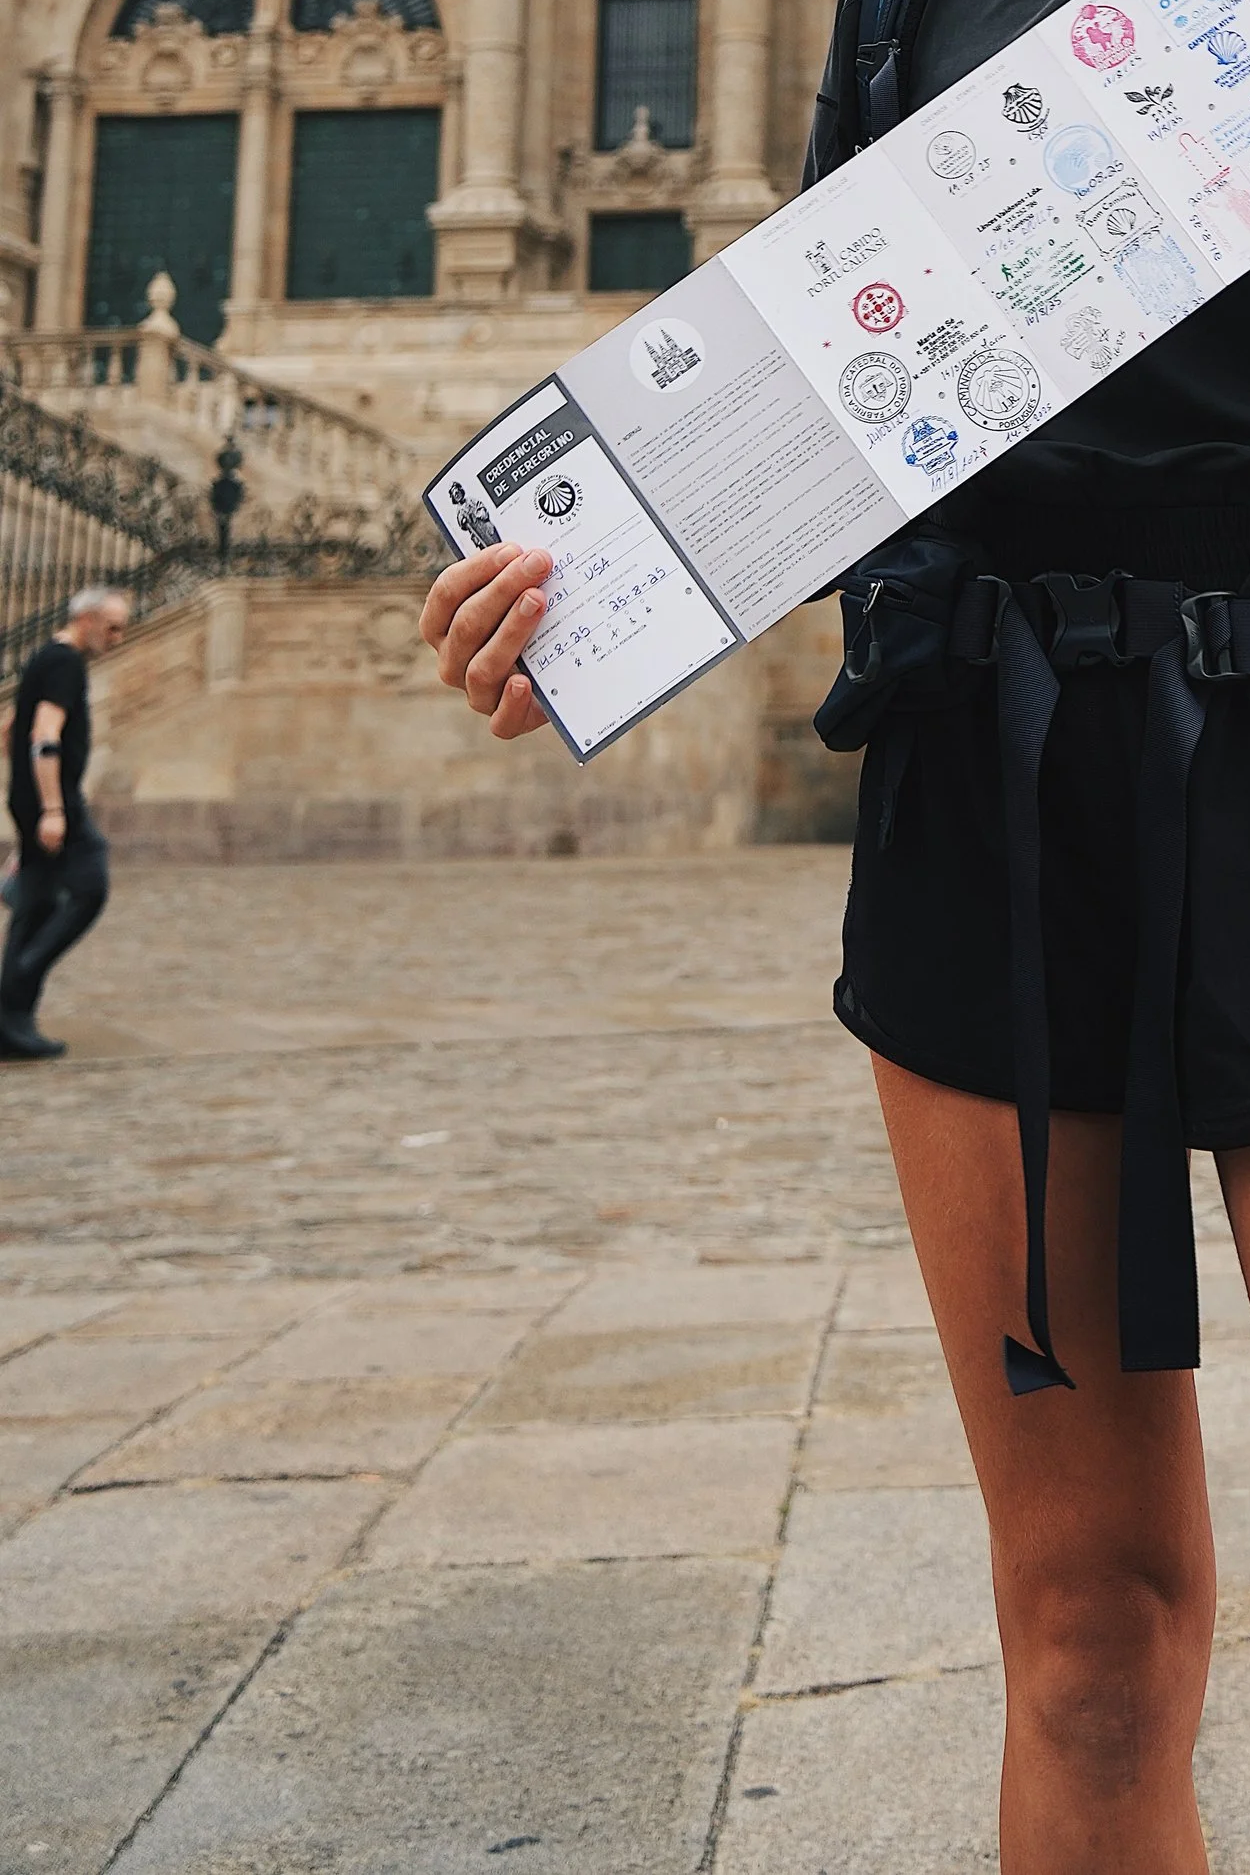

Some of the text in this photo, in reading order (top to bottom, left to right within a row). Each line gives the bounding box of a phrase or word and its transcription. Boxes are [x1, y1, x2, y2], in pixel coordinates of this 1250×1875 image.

[840, 228, 880, 260] CABIDO
[807, 238, 887, 297] PORTUCALENSE
[917, 332, 936, 347] Maria
[936, 325, 946, 333] da
[945, 318, 955, 327] Sé
[843, 355, 907, 422] FABRICA DA CATEDRAL DO PORTO
[960, 362, 979, 419] CAMINHO
[999, 398, 1036, 430] PORTUGUÊS
[485, 429, 551, 483] CREDENCIAL
[494, 431, 573, 497] DE PEREGRINO
[538, 482, 583, 525] Via Lusitana
[584, 557, 613, 581] USA
[609, 567, 666, 612] 25-8-25
